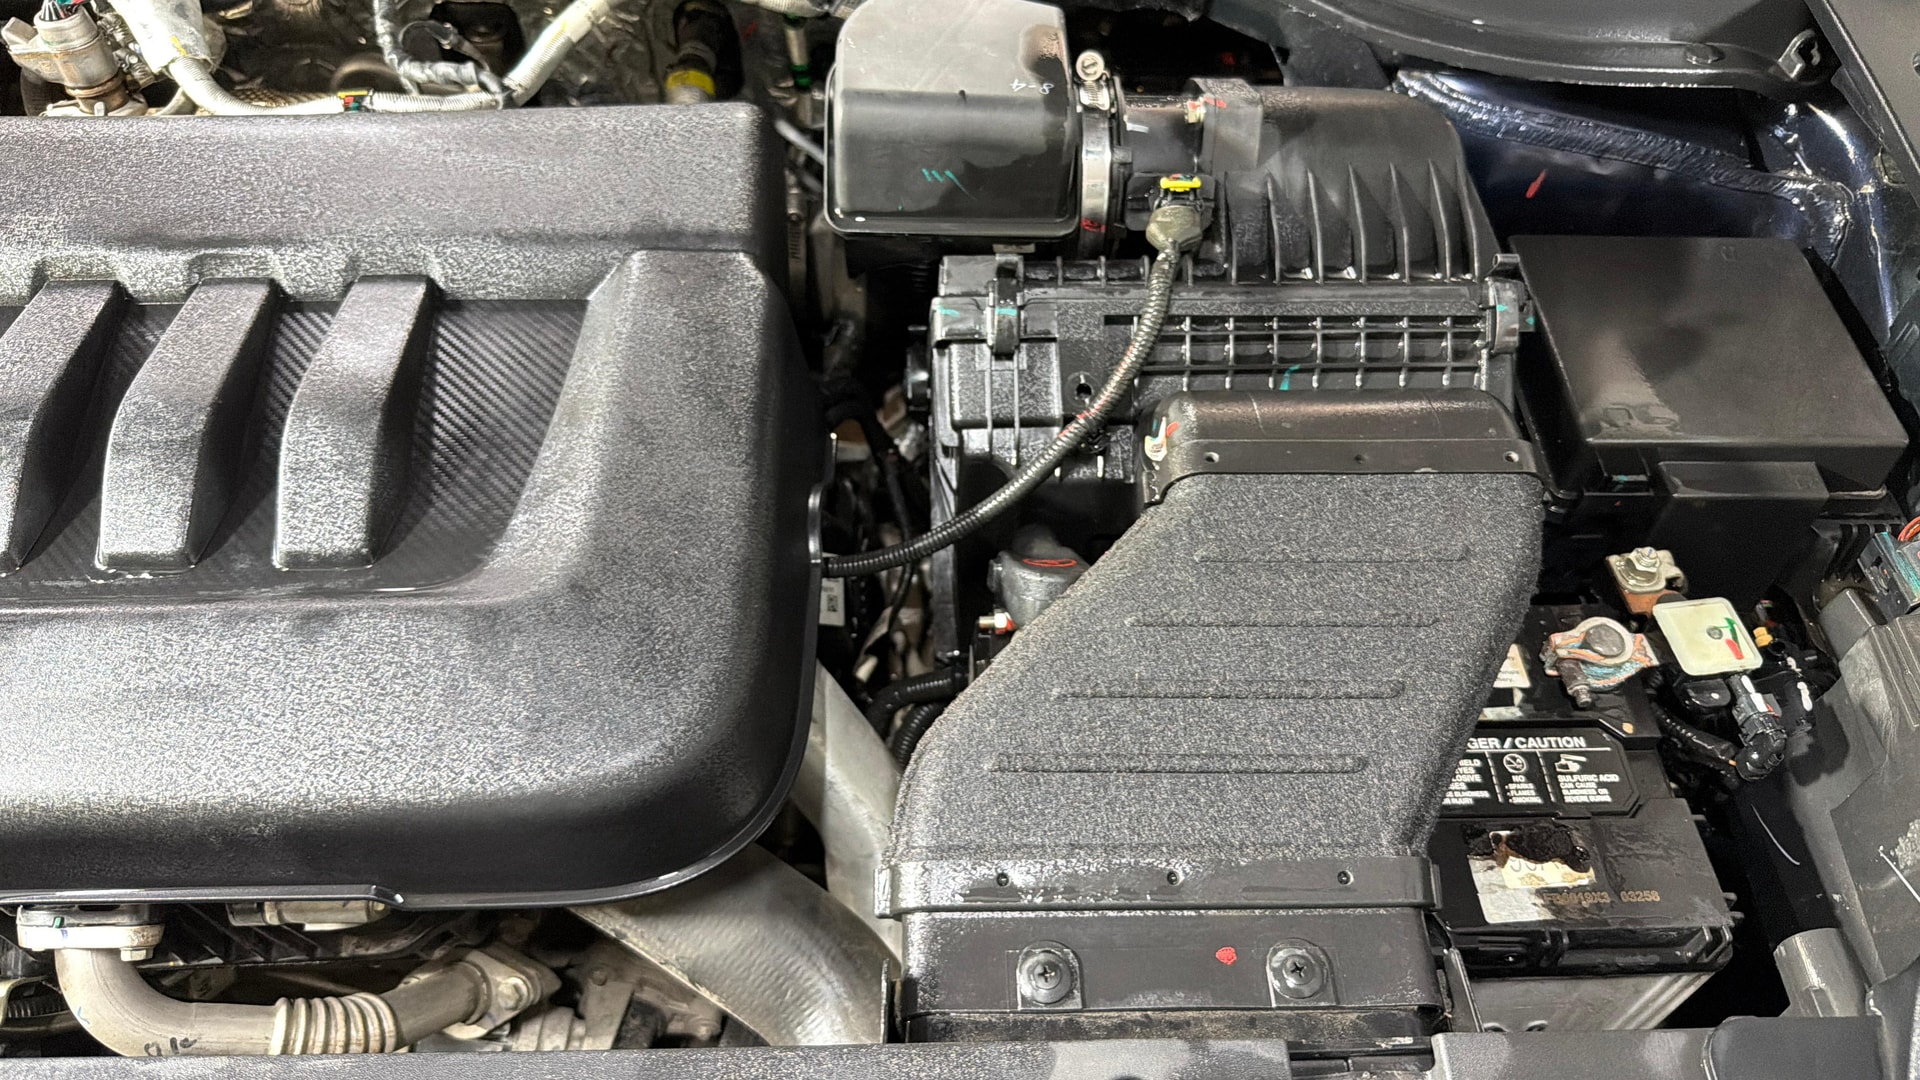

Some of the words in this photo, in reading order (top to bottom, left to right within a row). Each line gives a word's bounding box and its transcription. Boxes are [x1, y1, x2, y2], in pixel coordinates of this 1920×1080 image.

[1504, 737, 1514, 749] /
[1514, 736, 1587, 749] CAUTION
[1511, 775, 1526, 783] NO
[1557, 774, 1598, 783] SULFURIC
[1599, 773, 1620, 783] ACID
[1453, 790, 1491, 798] BLINDNESS
[1510, 789, 1537, 797] FLAMES
[1561, 788, 1598, 796] BLINDNESS
[1598, 788, 1609, 796] OR
[1512, 796, 1544, 804] SMOKING
[1564, 795, 1589, 803] SEVERE
[1589, 795, 1612, 803] BURNS
[1620, 890, 1661, 902] 03258
